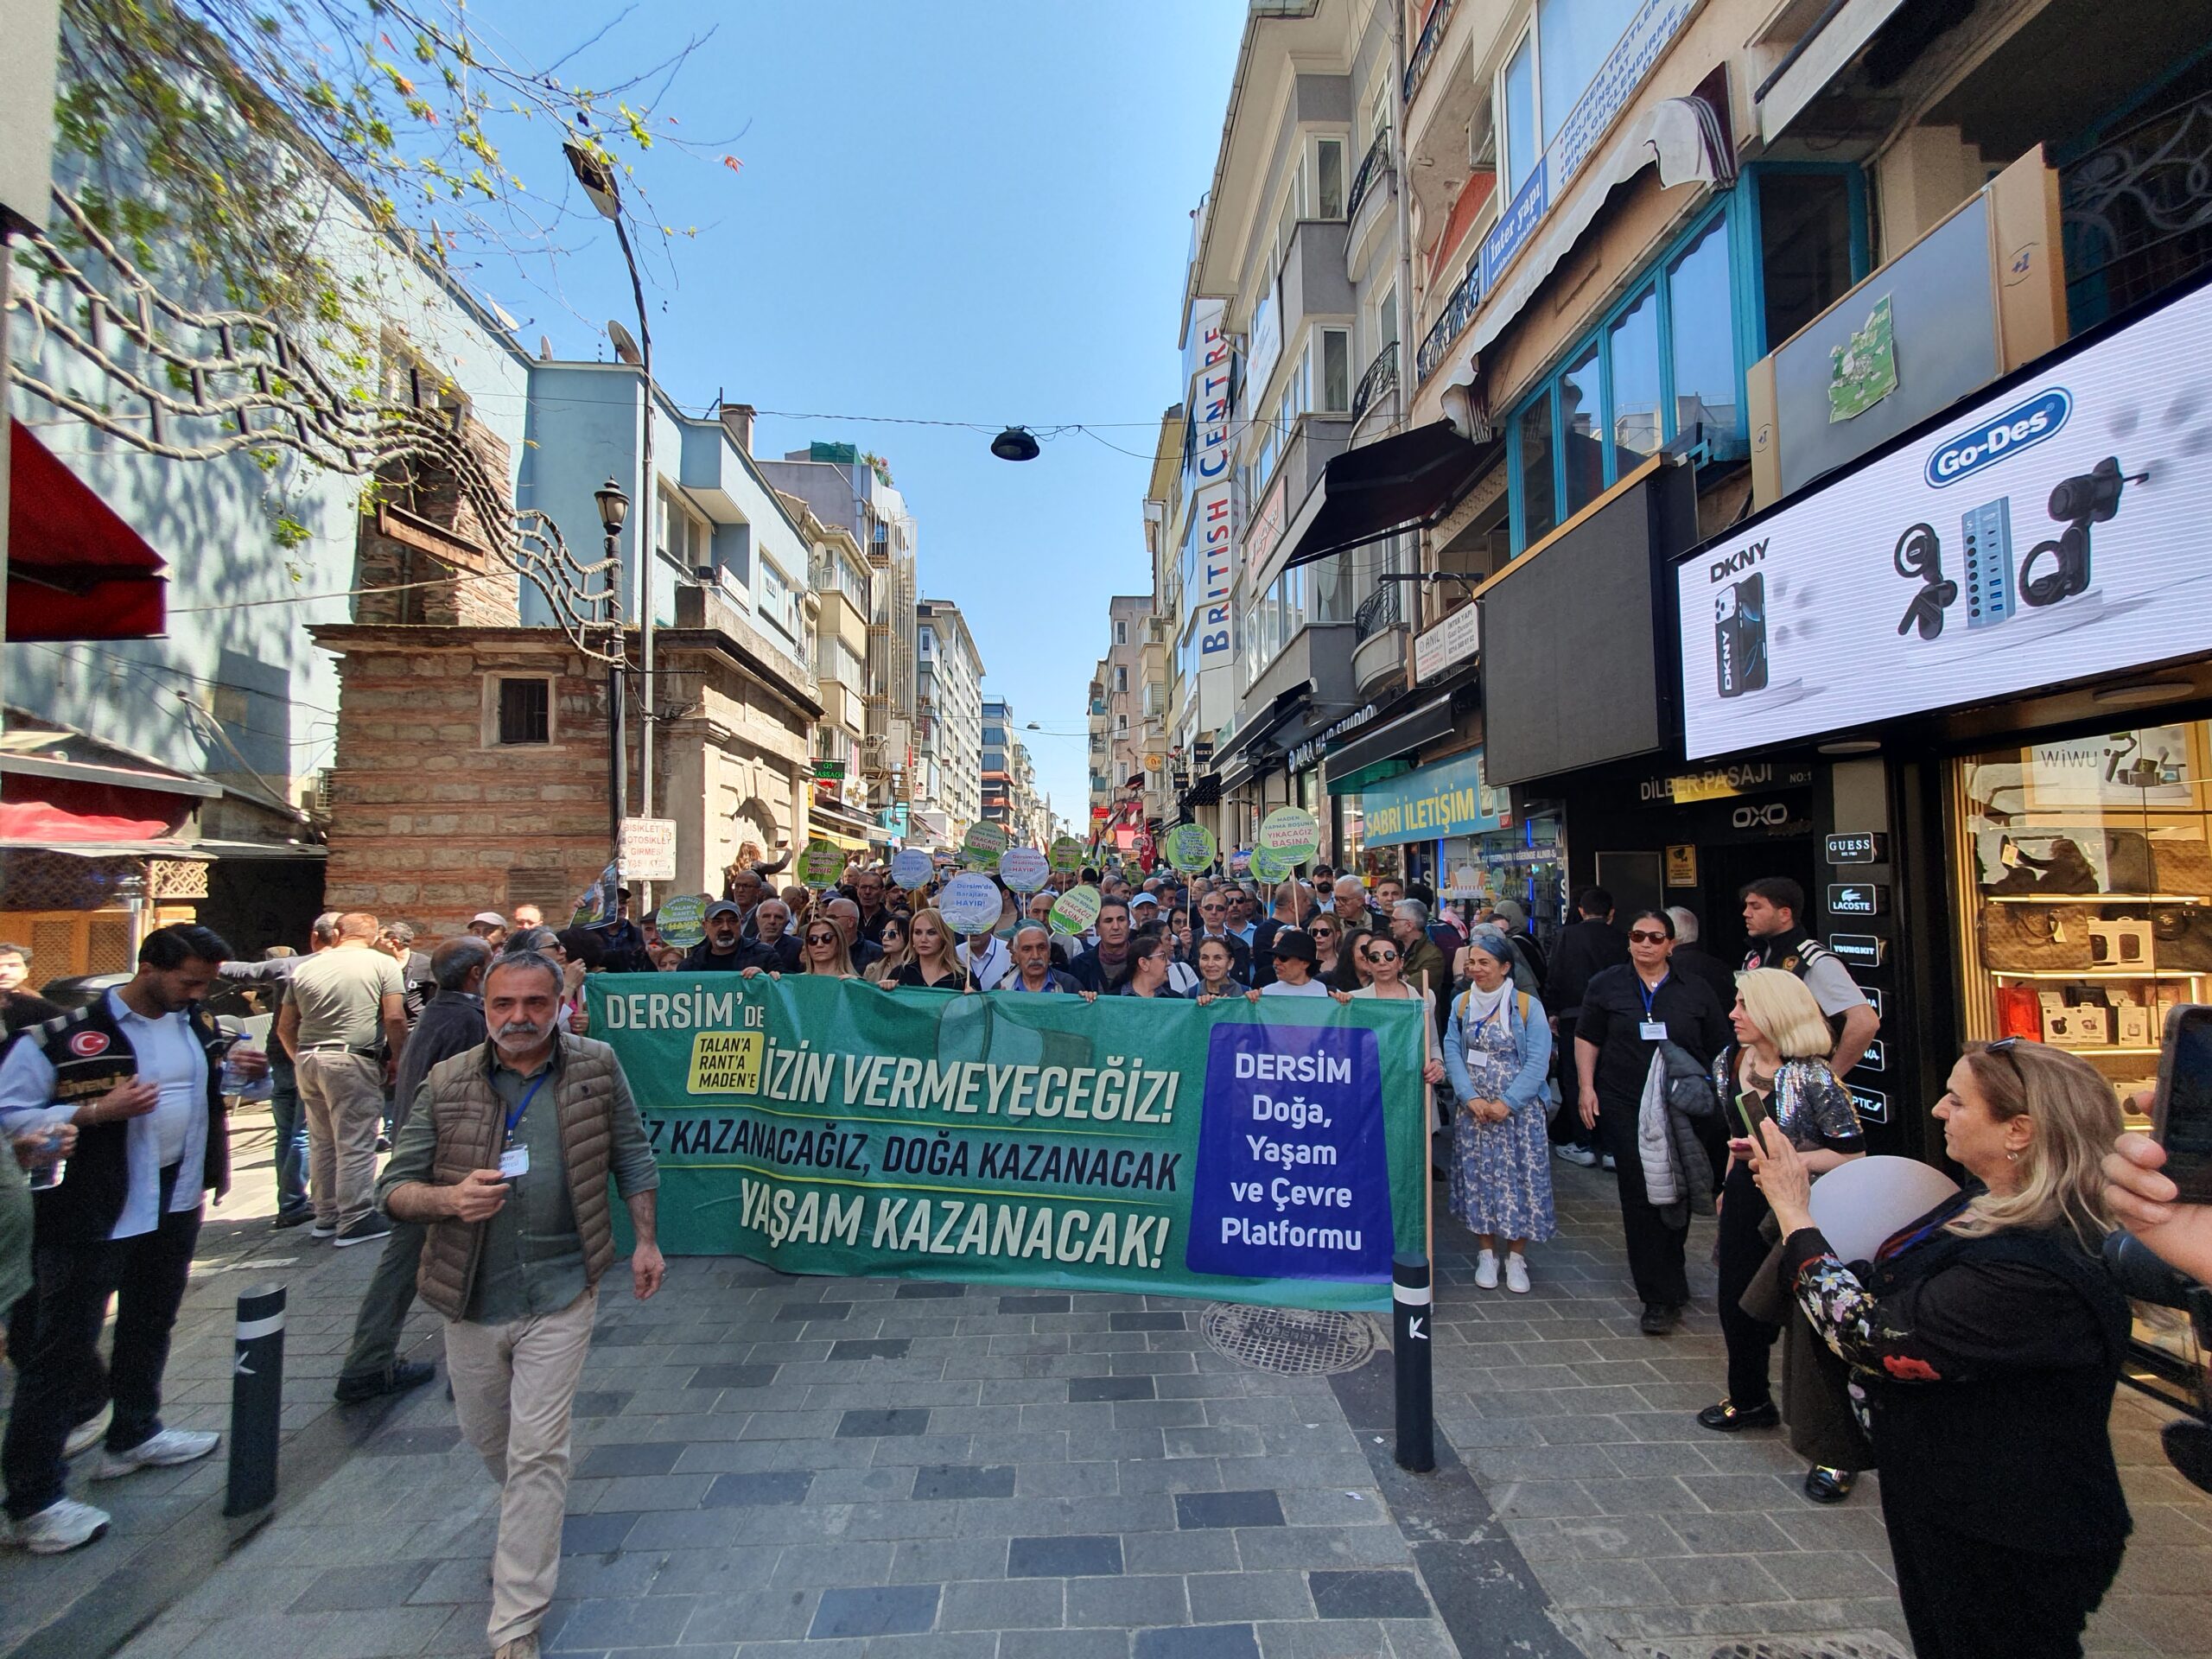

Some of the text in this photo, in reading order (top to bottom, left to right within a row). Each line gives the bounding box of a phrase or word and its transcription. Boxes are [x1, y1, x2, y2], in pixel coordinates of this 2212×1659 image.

[1937, 410, 2049, 477] Go-Des
[1199, 327, 1230, 655] BRITISH CENTRE
[1710, 537, 1770, 584] DKNY
[1722, 630, 1732, 690] DKNY
[1641, 775, 1700, 801] DİLBER
[1366, 782, 1475, 838] SABRİ İLETİŞİM
[1732, 803, 1788, 828] OXO
[1268, 829, 1313, 838] YIKACAĞIZ
[1829, 839, 1870, 851] GUESS
[1833, 900, 1871, 911] LACOSTE
[606, 984, 765, 1029] DERSİM' DE
[700, 1038, 751, 1052] TALAN'A
[699, 1055, 745, 1070] RANT'A
[763, 1037, 1179, 1122] İZİN VERMEYECEĞİZ!
[1236, 1050, 1351, 1084] DERSİM
[698, 1072, 757, 1088] MADEN'E
[1253, 1095, 1332, 1129] Doğa,
[670, 1118, 871, 1176] KAZANACAĞIZ,
[882, 1130, 968, 1177] DOĞA
[977, 1141, 1182, 1192] KAZANACAK
[1246, 1135, 1337, 1171] Yaşam
[1231, 1177, 1352, 1211] ve Çevre
[741, 1178, 1170, 1269] YAŞAM KAZANACAK!
[1221, 1217, 1362, 1250] Platformu
